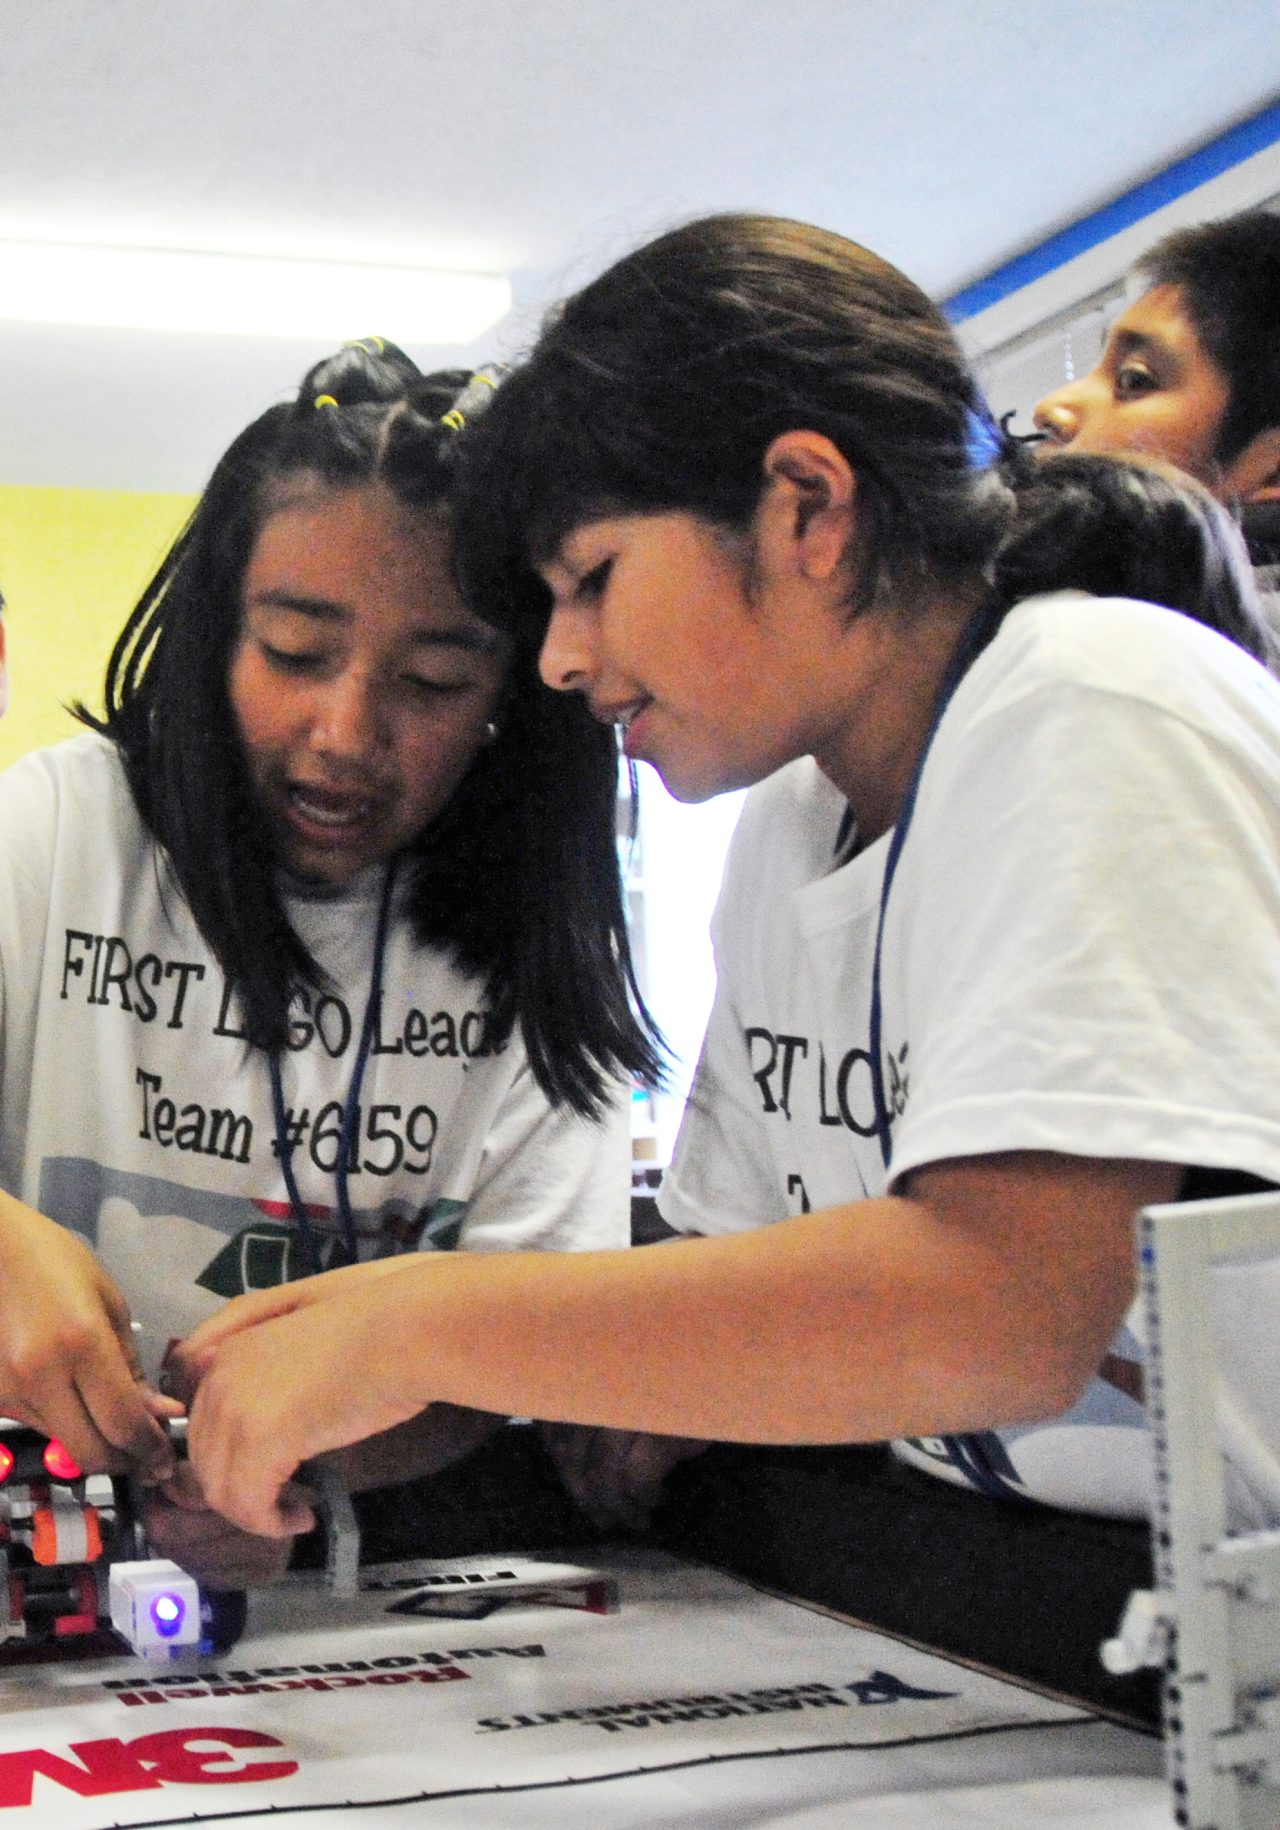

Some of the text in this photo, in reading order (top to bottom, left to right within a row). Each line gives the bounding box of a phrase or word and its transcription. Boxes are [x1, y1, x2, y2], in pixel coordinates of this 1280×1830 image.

[59, 928, 205, 1030] FIRST
[213, 976, 351, 1058] LGO
[135, 1066, 438, 1176] Team #6159
[101, 1644, 546, 1690] Automation
[116, 1665, 472, 1707] Rockwell
[580, 1694, 851, 1734] NATIONAL
